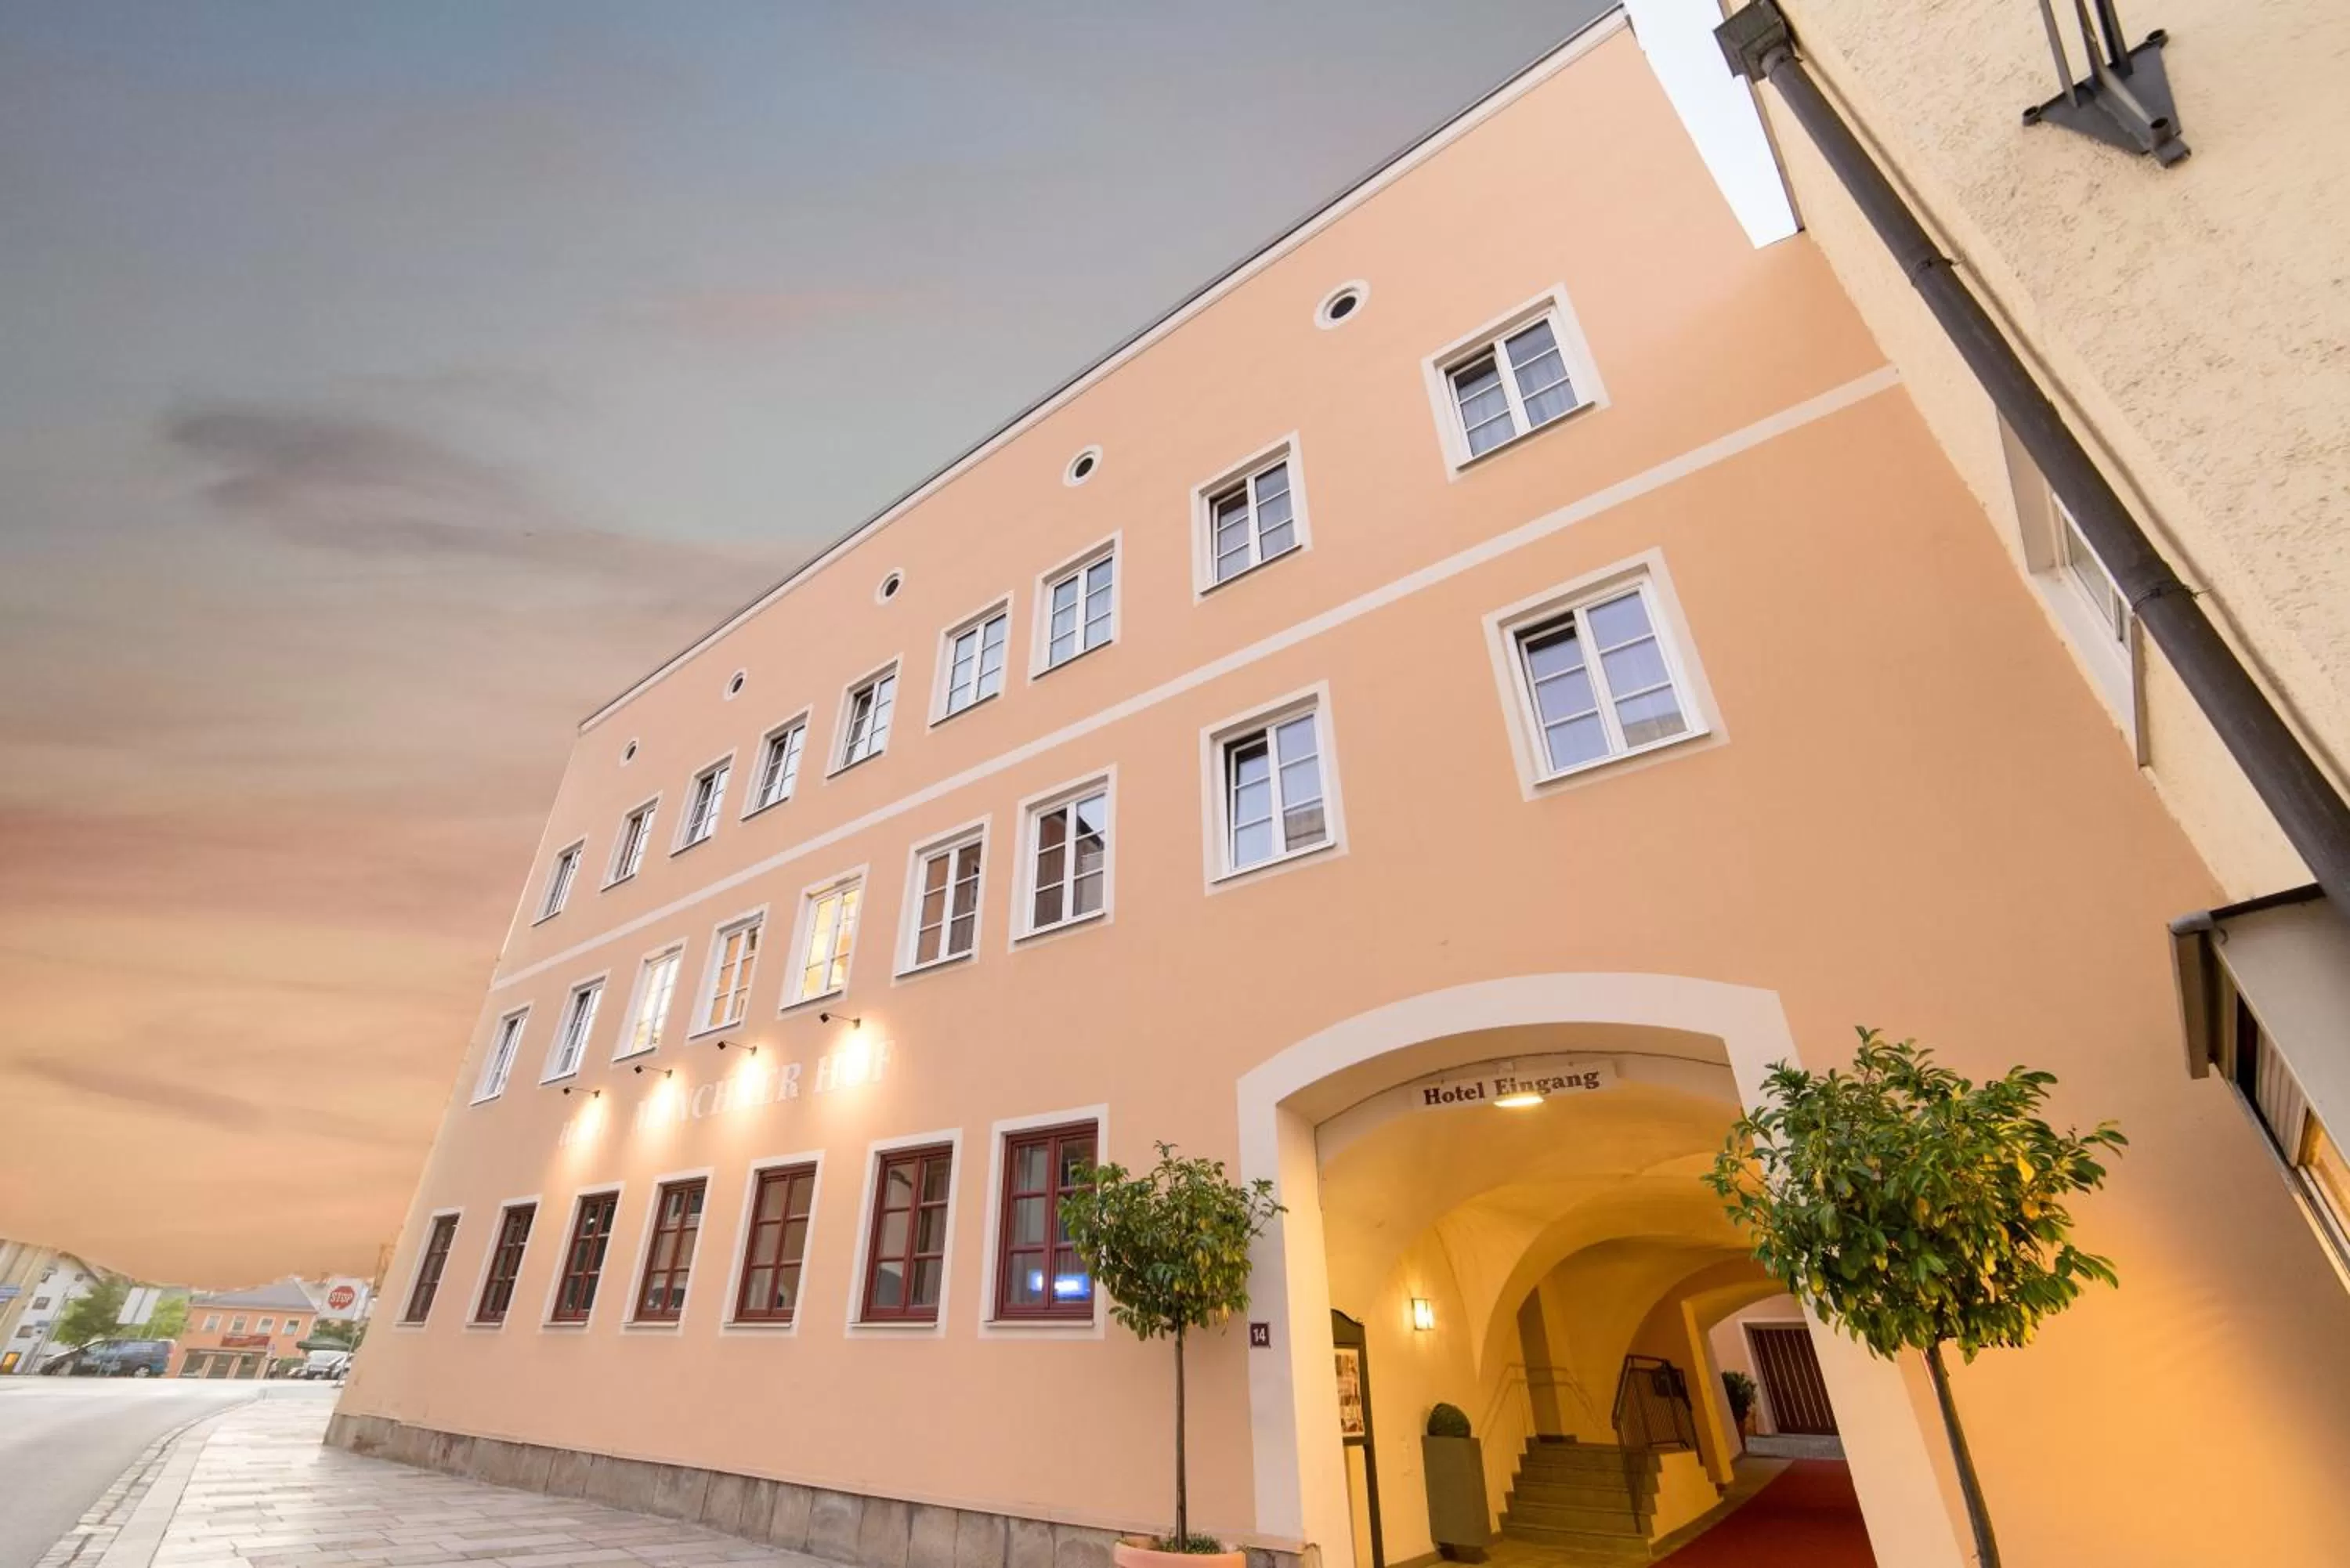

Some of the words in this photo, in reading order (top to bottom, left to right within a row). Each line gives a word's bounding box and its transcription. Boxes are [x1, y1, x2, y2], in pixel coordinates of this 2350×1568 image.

[1423, 1082, 1486, 1105] Hotel
[1494, 1070, 1600, 1097] Eingang
[330, 1292, 353, 1303] STOP
[1253, 1328, 1266, 1342] 14
